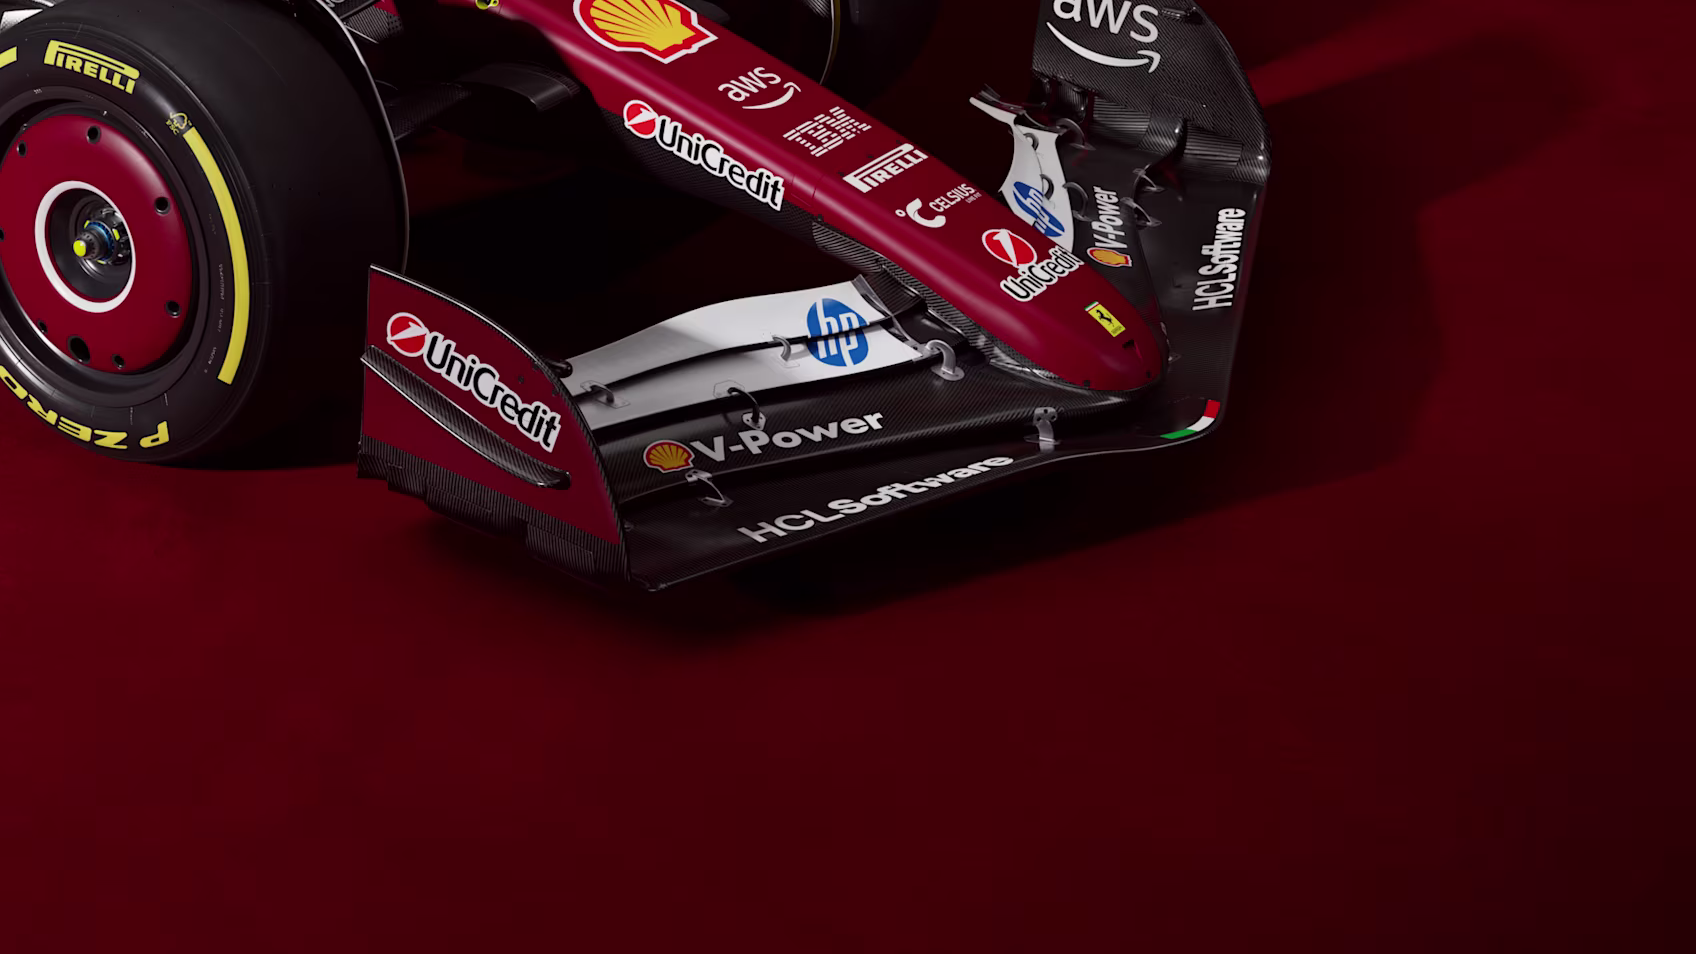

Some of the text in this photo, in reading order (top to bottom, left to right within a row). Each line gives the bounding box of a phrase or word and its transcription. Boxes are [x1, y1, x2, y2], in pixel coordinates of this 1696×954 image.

[43, 39, 141, 95] PIRELLI
[718, 67, 781, 102] aws
[782, 106, 872, 157] IBM
[658, 117, 783, 209] UniCredit
[842, 143, 929, 193] PIRELLI
[929, 183, 976, 213] CELSIUS
[1092, 185, 1128, 249] V-Power
[1002, 246, 1083, 300] UniCredit
[1191, 207, 1247, 311] HCLSoftware
[812, 298, 864, 366] hp
[426, 334, 559, 448] UniCredit
[690, 412, 884, 463] V-Power
[737, 456, 1015, 544] HCLSoftware
